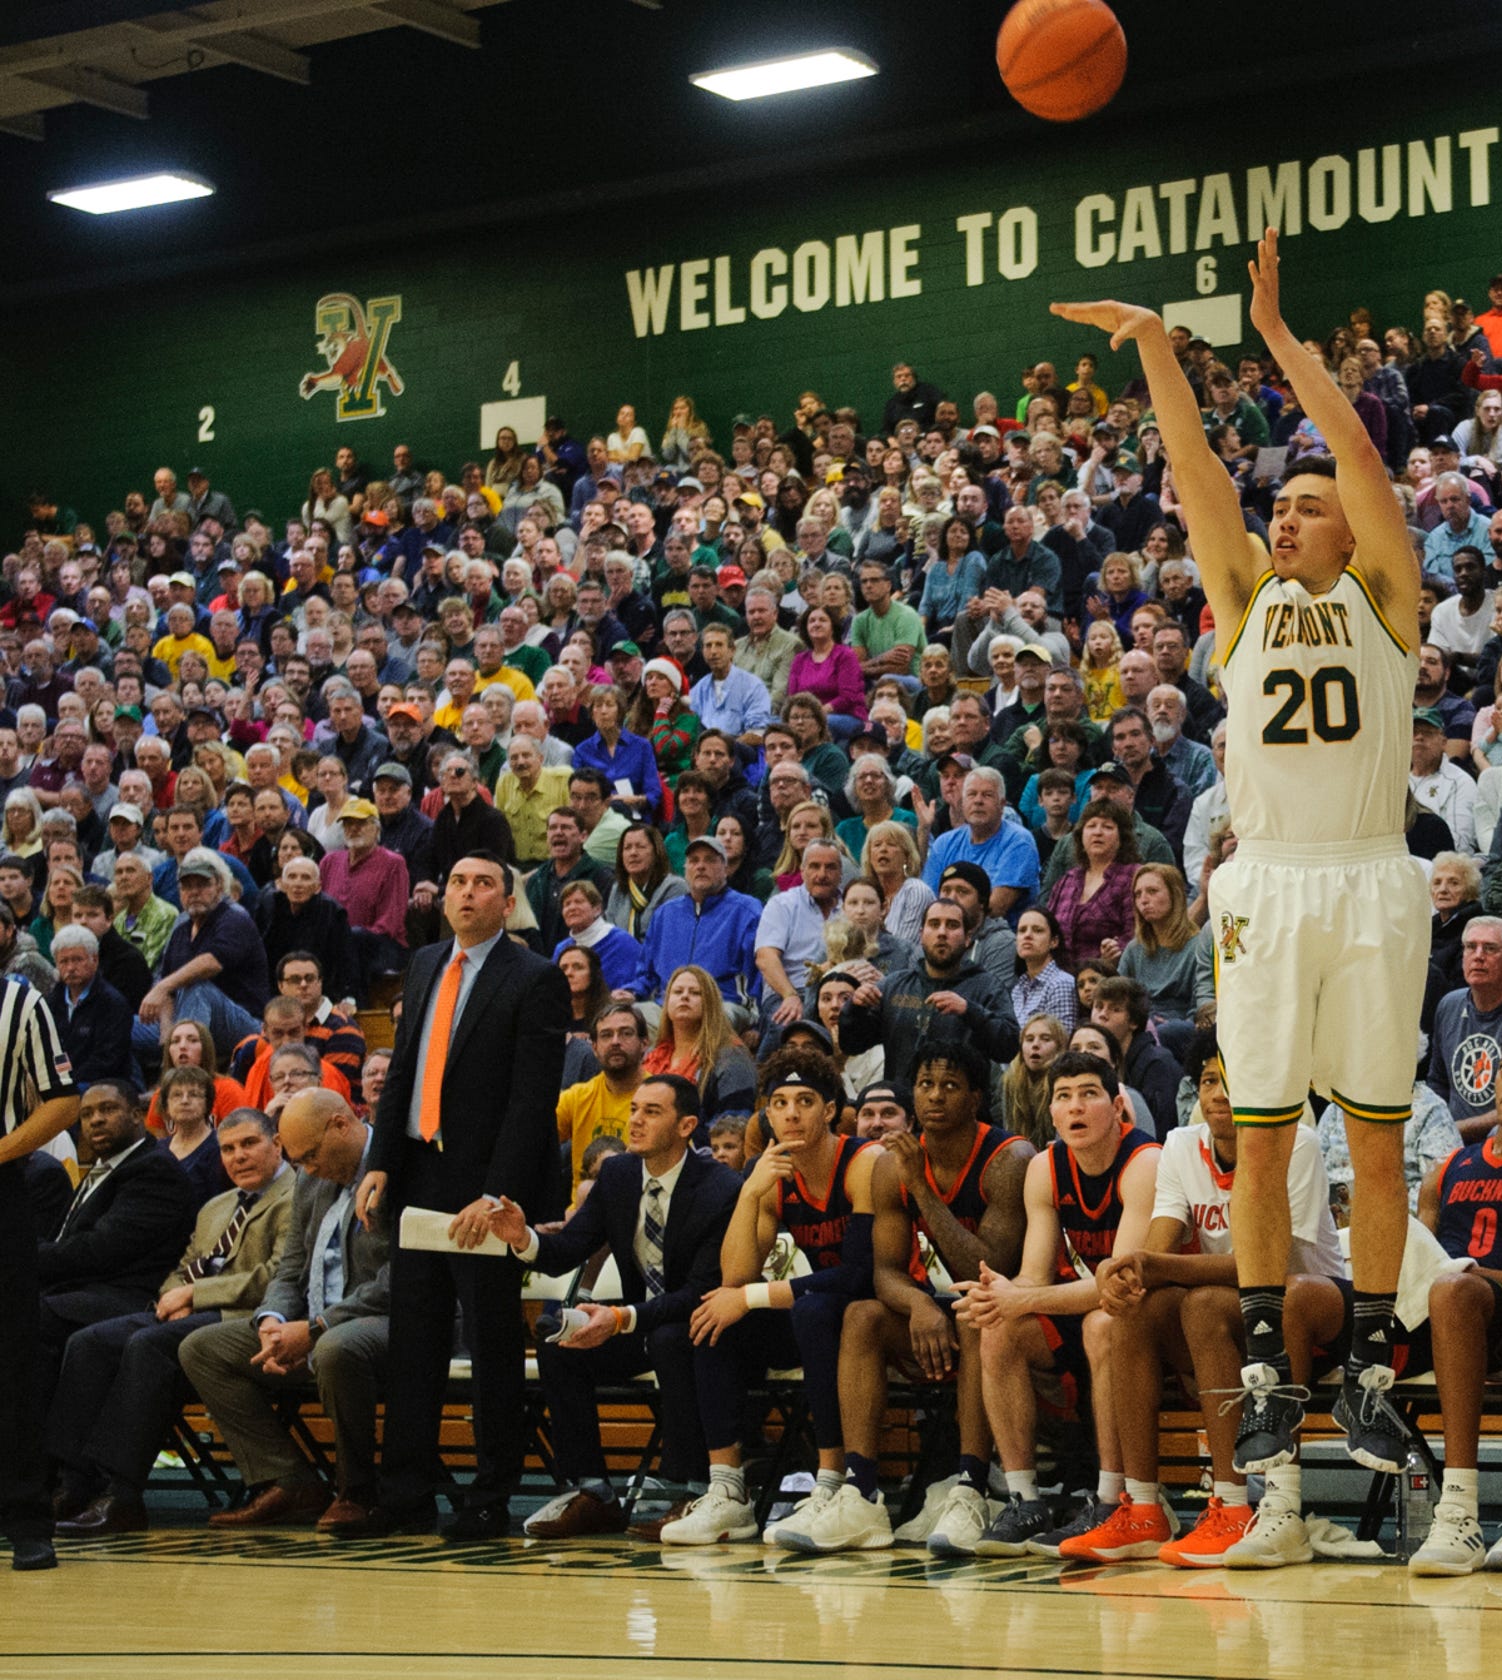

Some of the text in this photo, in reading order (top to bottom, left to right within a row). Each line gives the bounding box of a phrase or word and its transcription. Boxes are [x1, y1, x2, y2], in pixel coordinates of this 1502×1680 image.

[626, 223, 921, 338] WELCOME
[956, 206, 1039, 287] TO
[1074, 126, 1500, 269] CATAMOUNT
[1195, 255, 1218, 295] 6
[502, 360, 521, 397] 4
[198, 405, 215, 443] 2
[1262, 666, 1362, 745] 20
[1467, 1206, 1499, 1259] 0
